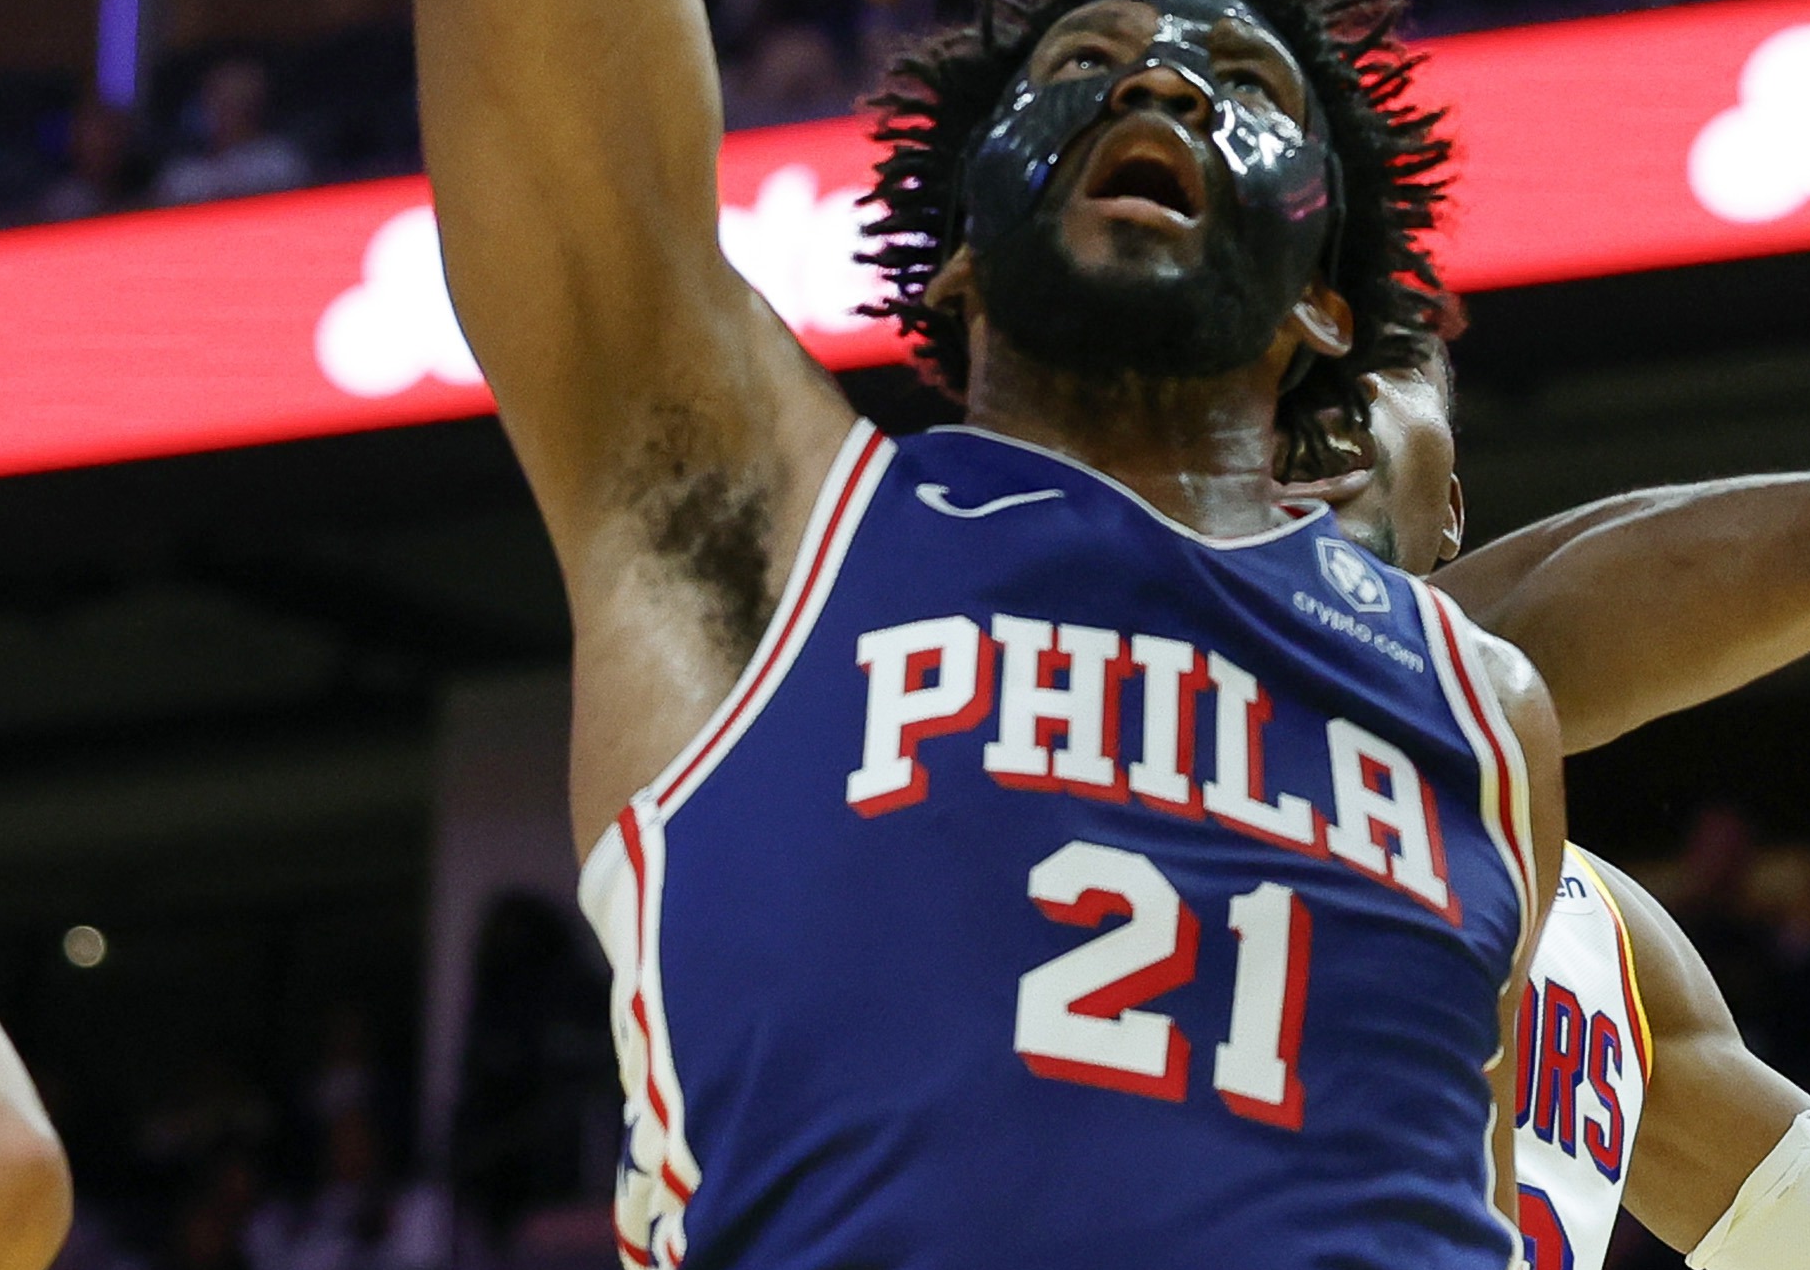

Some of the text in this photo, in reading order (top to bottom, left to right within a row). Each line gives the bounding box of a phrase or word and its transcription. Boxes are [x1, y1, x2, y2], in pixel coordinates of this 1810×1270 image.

[846, 613, 1463, 929] PHILA
[1293, 591, 1425, 674] crypto.com
[1014, 840, 1314, 1131] 21
